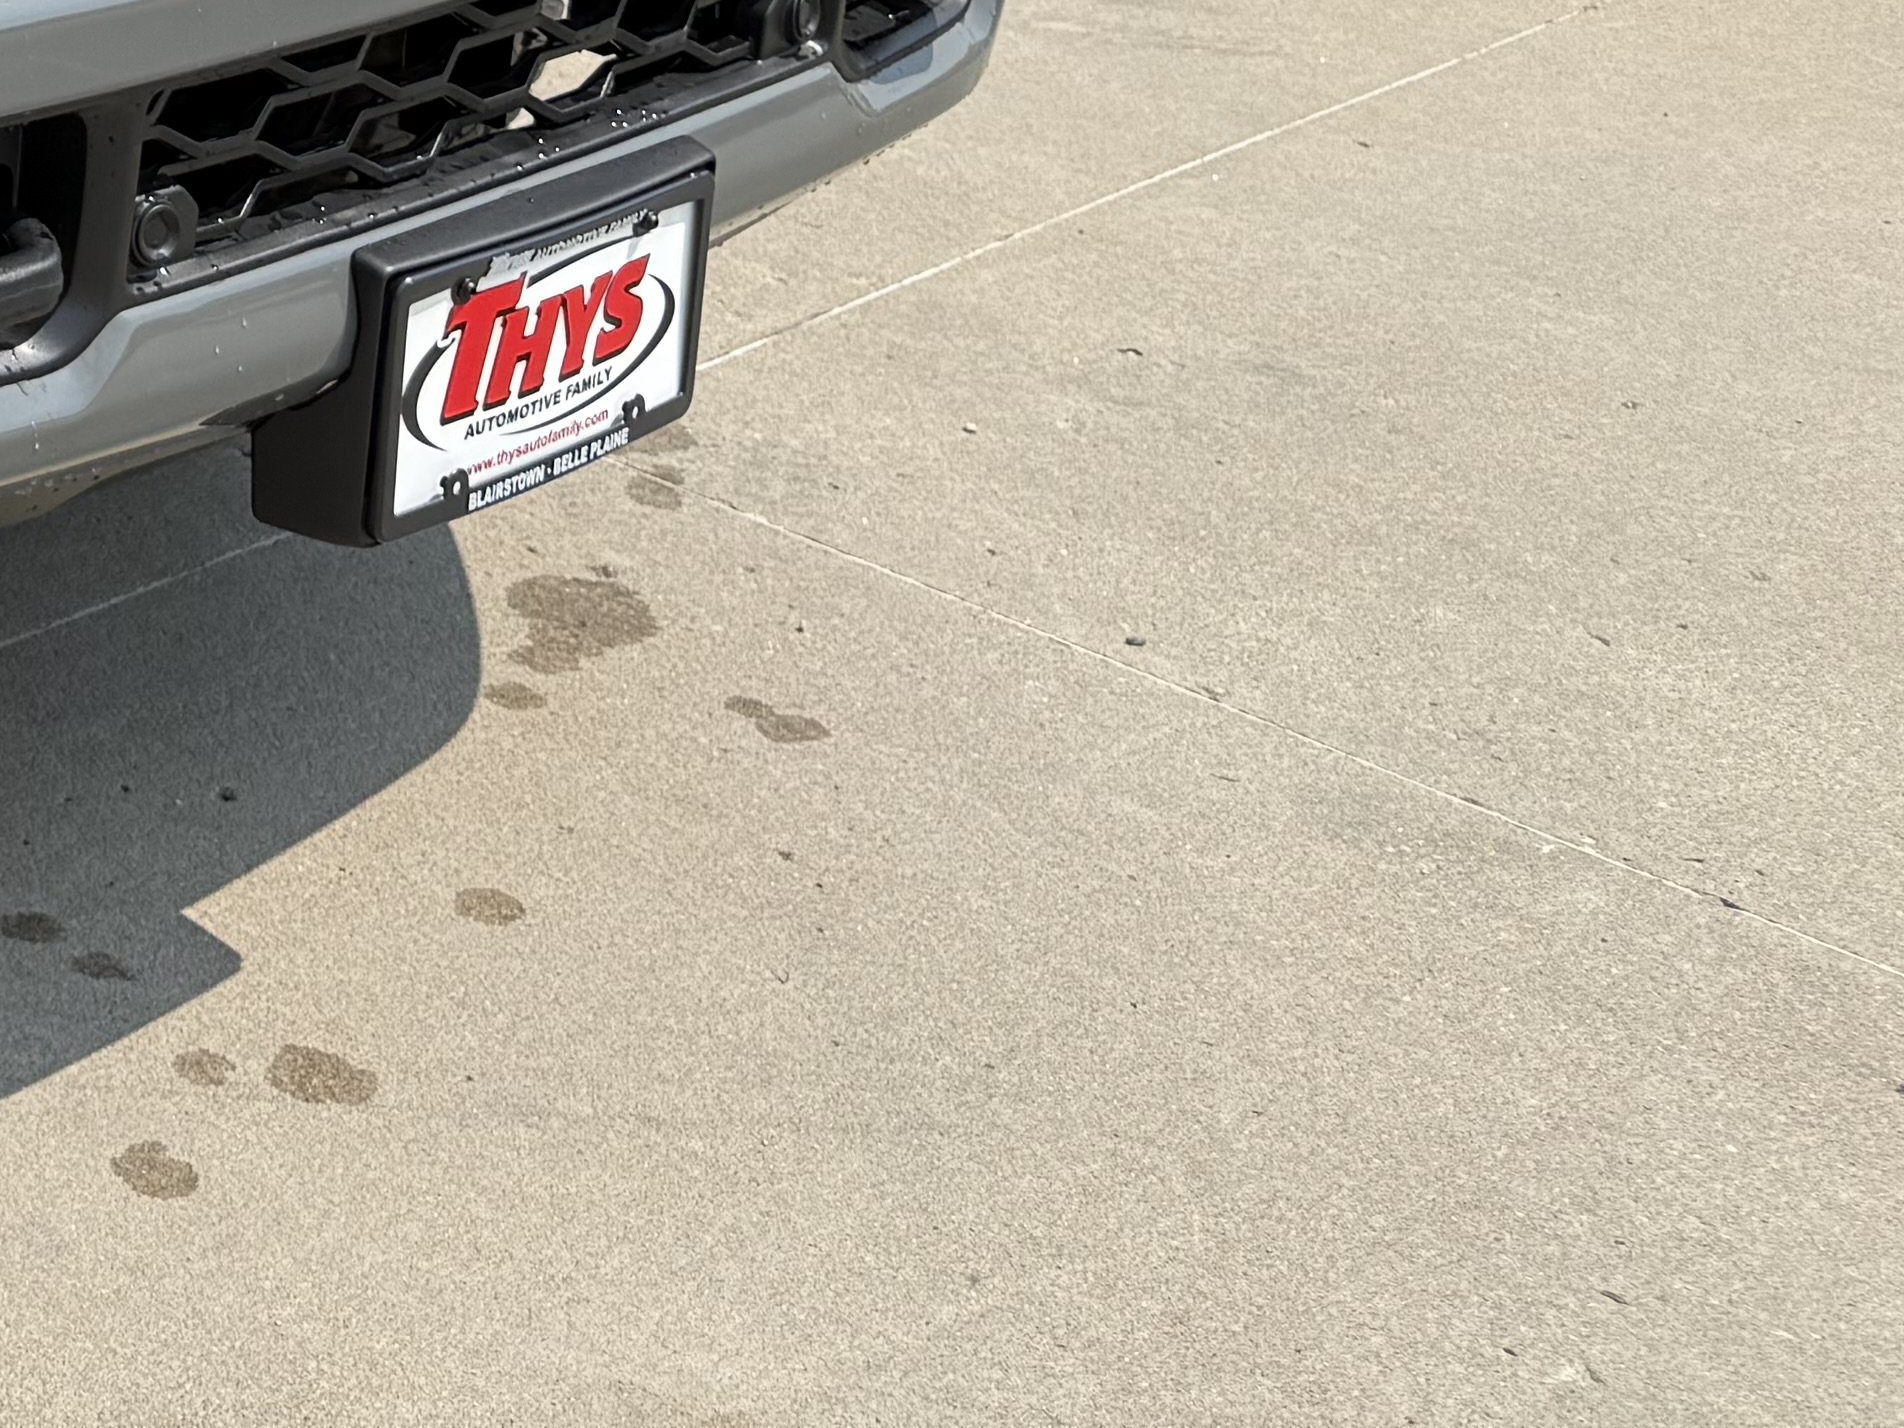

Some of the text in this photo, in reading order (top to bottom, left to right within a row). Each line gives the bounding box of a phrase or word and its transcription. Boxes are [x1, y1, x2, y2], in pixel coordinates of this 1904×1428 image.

[440, 252, 650, 427] THYS
[464, 365, 613, 441] AUTOMOTIVE FAMILY
[468, 427, 630, 512] BLAIRSTOWN BELLE PLAINE
